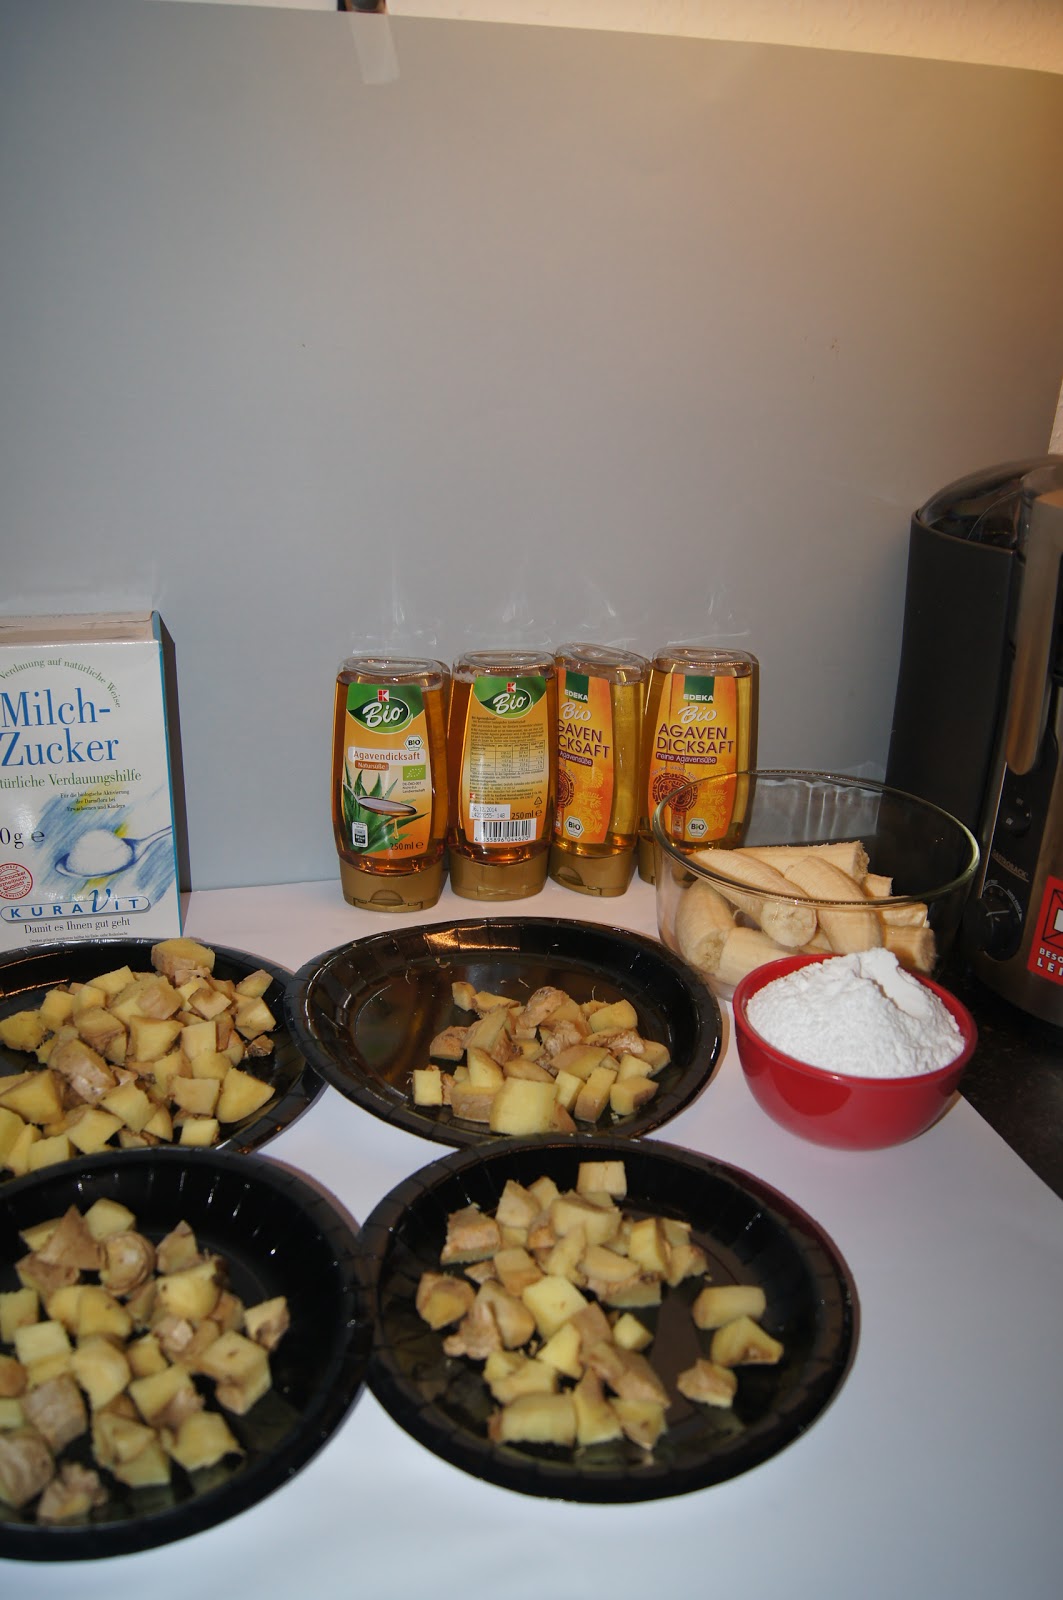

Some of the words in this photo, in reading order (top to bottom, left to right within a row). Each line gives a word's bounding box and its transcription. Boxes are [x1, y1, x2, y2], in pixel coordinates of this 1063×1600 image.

[0, 659, 45, 680] Verdauung
[47, 658, 62, 667] auf
[64, 661, 106, 684] natürliche
[107, 682, 121, 708] Weise
[492, 692, 527, 714] Bio
[564, 689, 589, 701] EDEKA
[0, 687, 111, 728] Milch-
[362, 702, 404, 728] Bio
[561, 701, 592, 721] Bio
[677, 705, 717, 724] Bio
[658, 723, 728, 740] AGAVEN
[0, 728, 119, 767] Zucker
[656, 736, 734, 754] DICKSAFT
[354, 750, 421, 761] Agavendicksaft
[656, 752, 675, 760] reine
[48, 768, 142, 786] Verdauungshilfe
[24, 922, 52, 934] Damit
[67, 920, 93, 931] Ihnen
[95, 920, 109, 931] gut
[111, 917, 131, 929] geht
[1039, 947, 1063, 964] BESO
